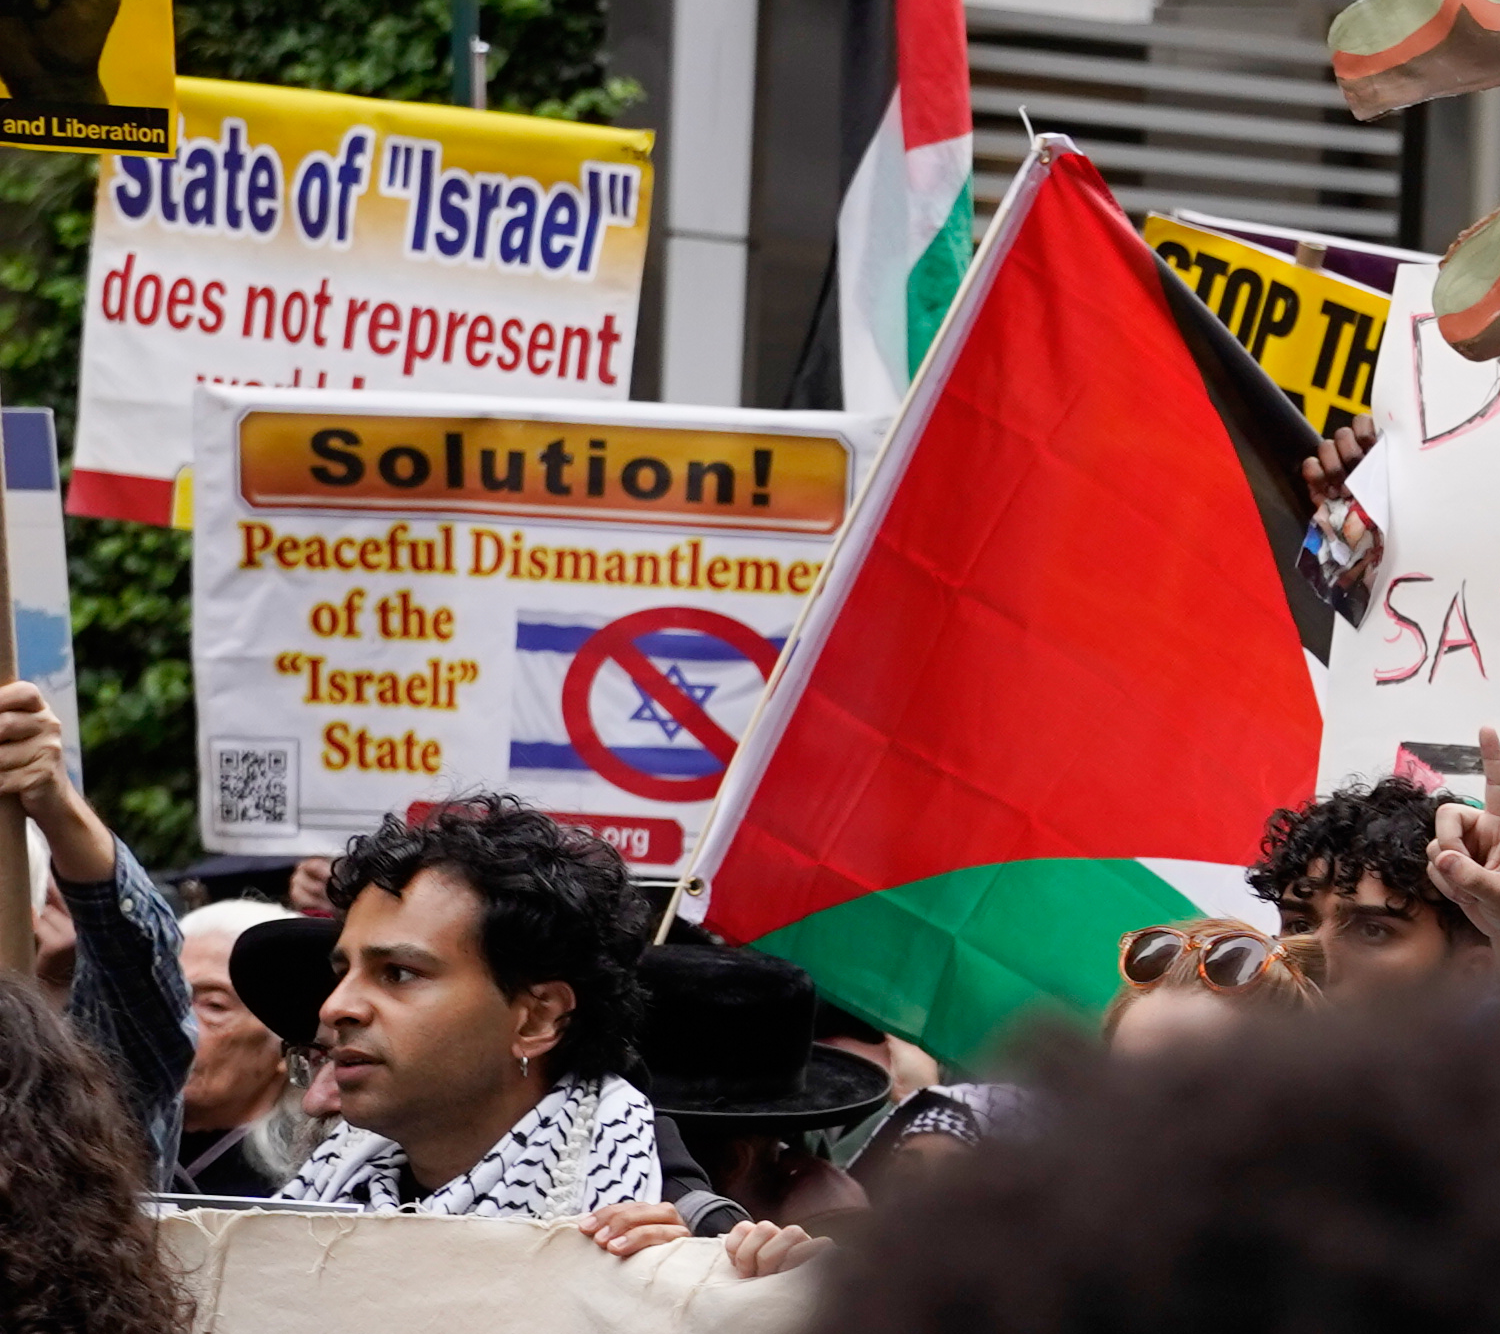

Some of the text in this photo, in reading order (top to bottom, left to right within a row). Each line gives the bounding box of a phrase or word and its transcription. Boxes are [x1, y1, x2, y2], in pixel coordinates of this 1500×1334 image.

[4, 116, 166, 147] and Liberation
[298, 133, 368, 243] of
[388, 141, 636, 273] "Israel"
[102, 252, 623, 385] does not represent
[309, 428, 775, 508] Solution!
[239, 522, 825, 595] Peaceful Dismantleme
[311, 590, 455, 643] of the
[322, 723, 442, 776] State
